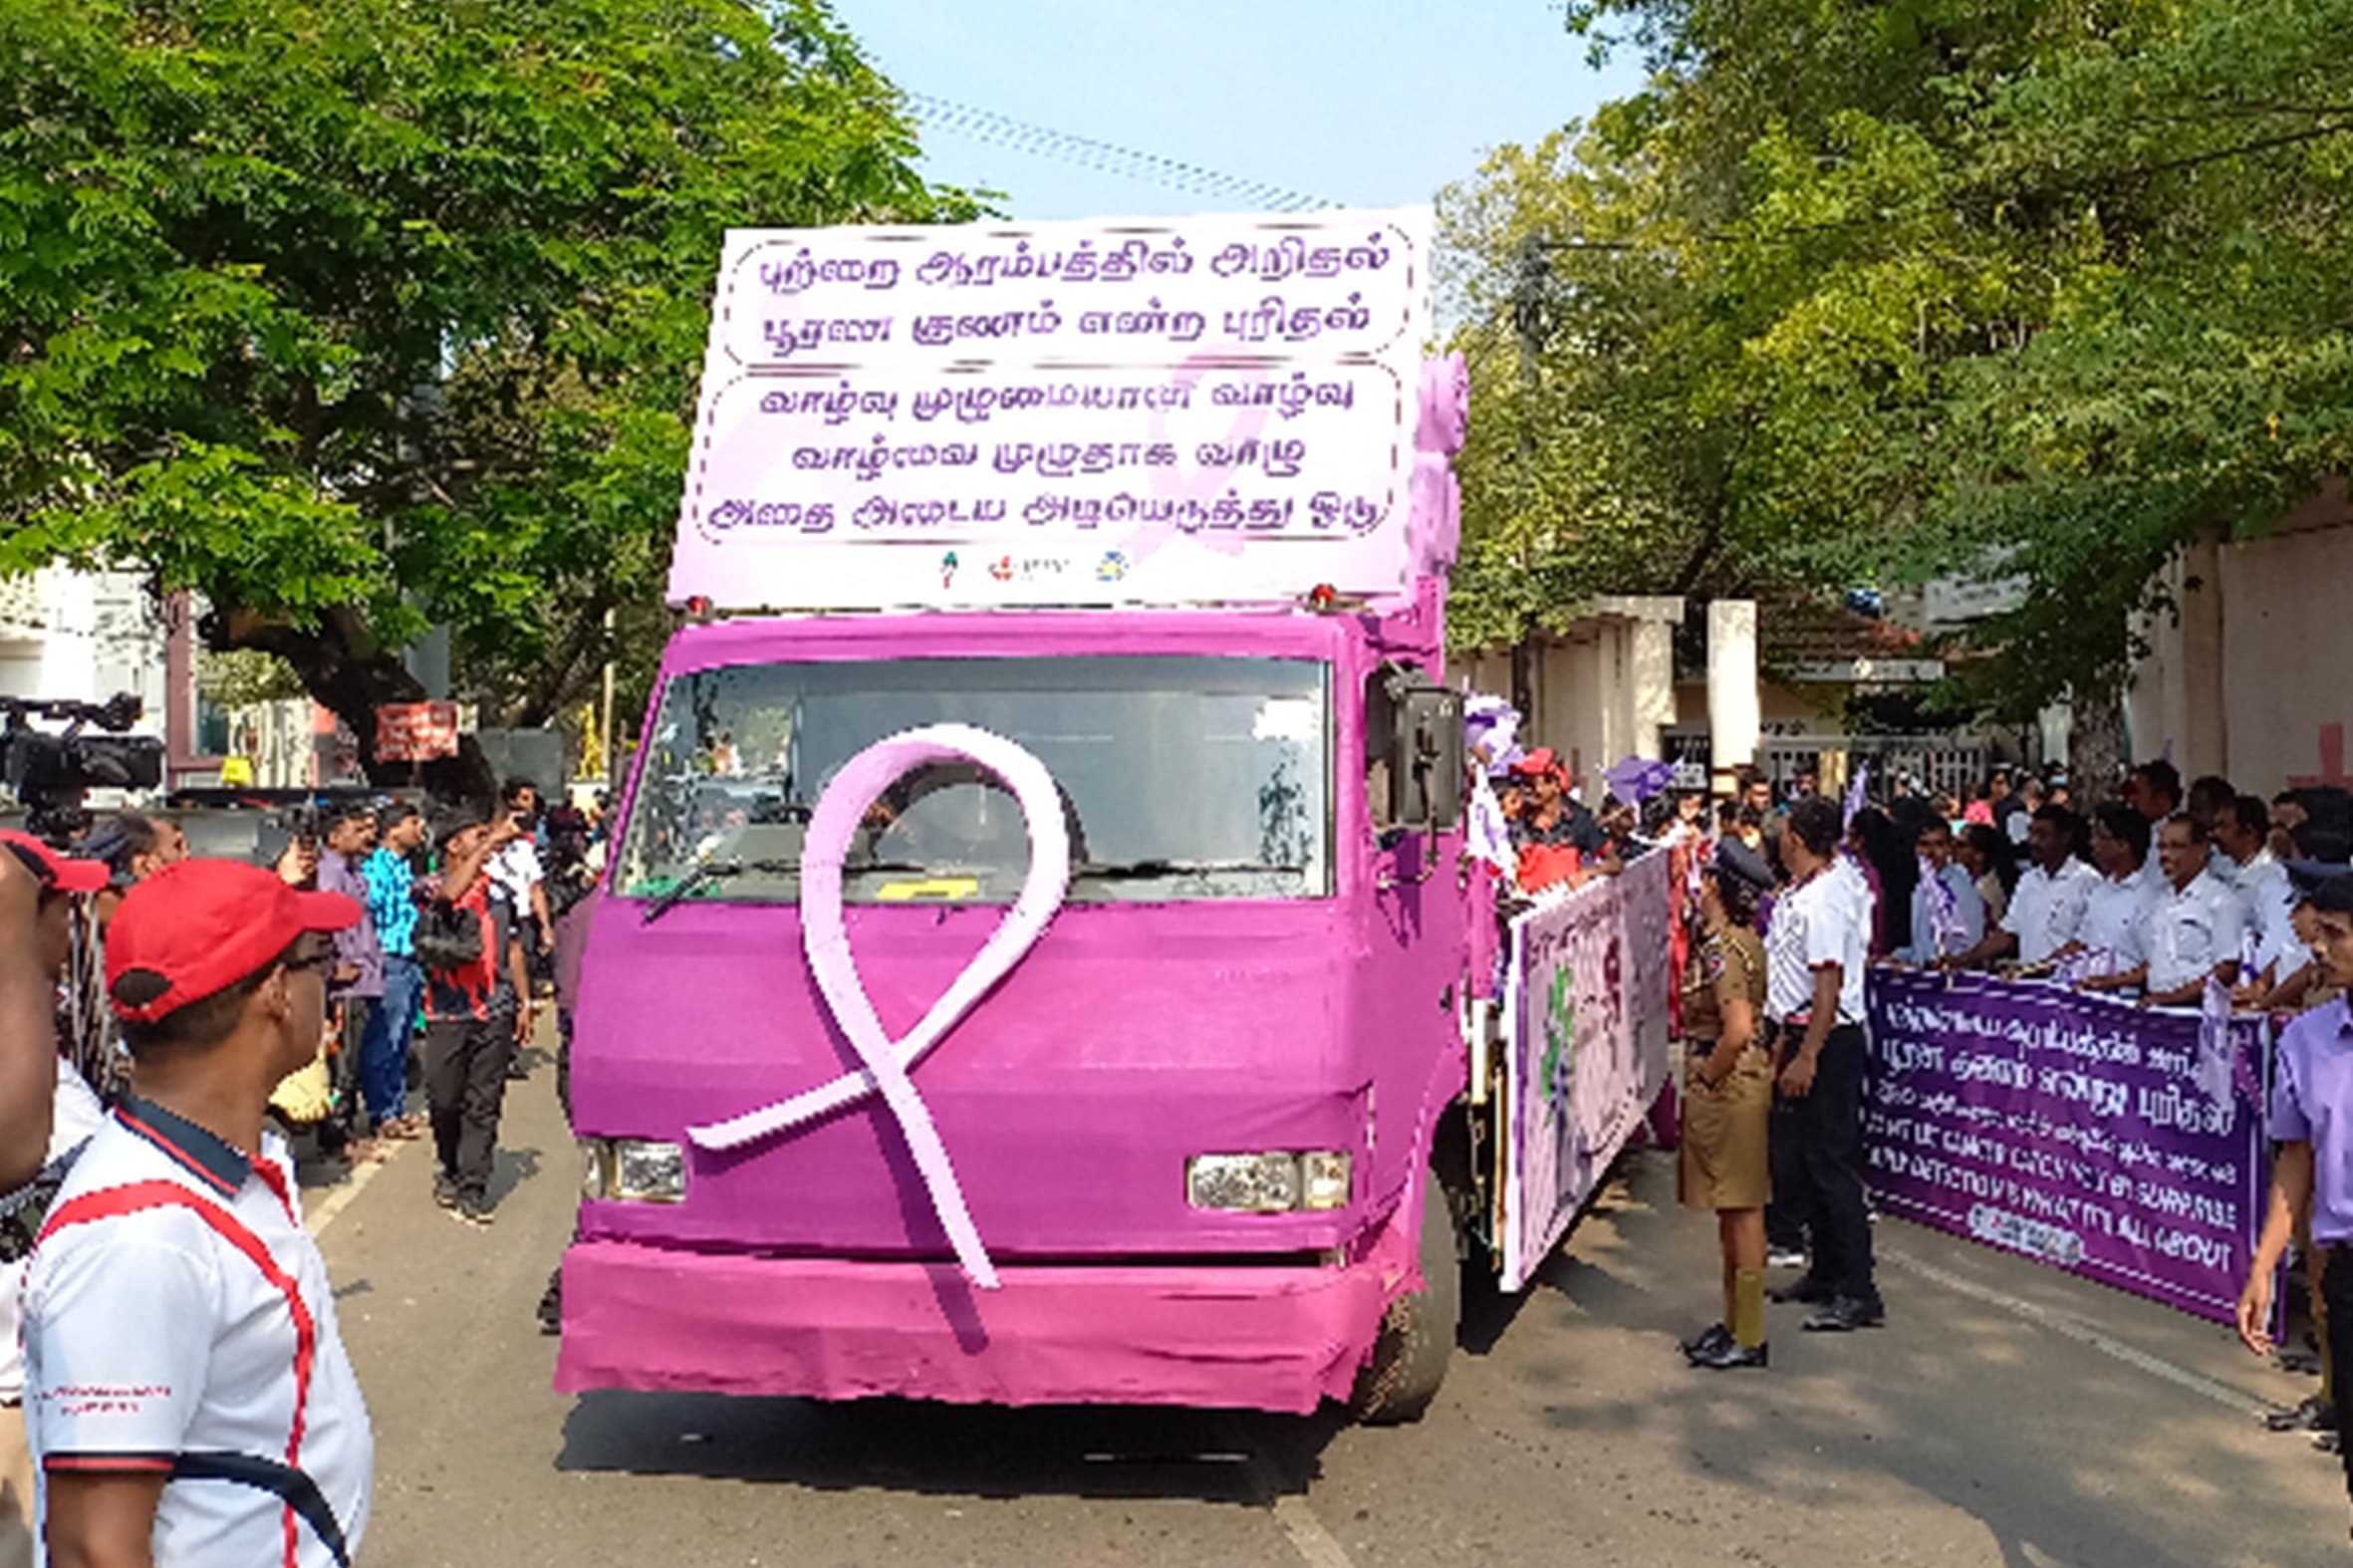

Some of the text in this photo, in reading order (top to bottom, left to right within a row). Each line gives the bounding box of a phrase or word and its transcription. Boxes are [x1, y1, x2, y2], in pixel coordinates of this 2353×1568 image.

[760, 232, 1390, 295] புற்றை ஆரம்பத்தில் அறிதல்
[763, 292, 1370, 358] பூரண குணம் என்ற புரிதல்
[759, 372, 1354, 425] வாழ்வு முழுமையான வாழ்வு
[792, 432, 1306, 481] வாழ்வை முழுதாக வாழு
[708, 498, 835, 533] அதை
[852, 496, 1006, 530] அடைய
[1022, 488, 1293, 534] அடியெடுத்து
